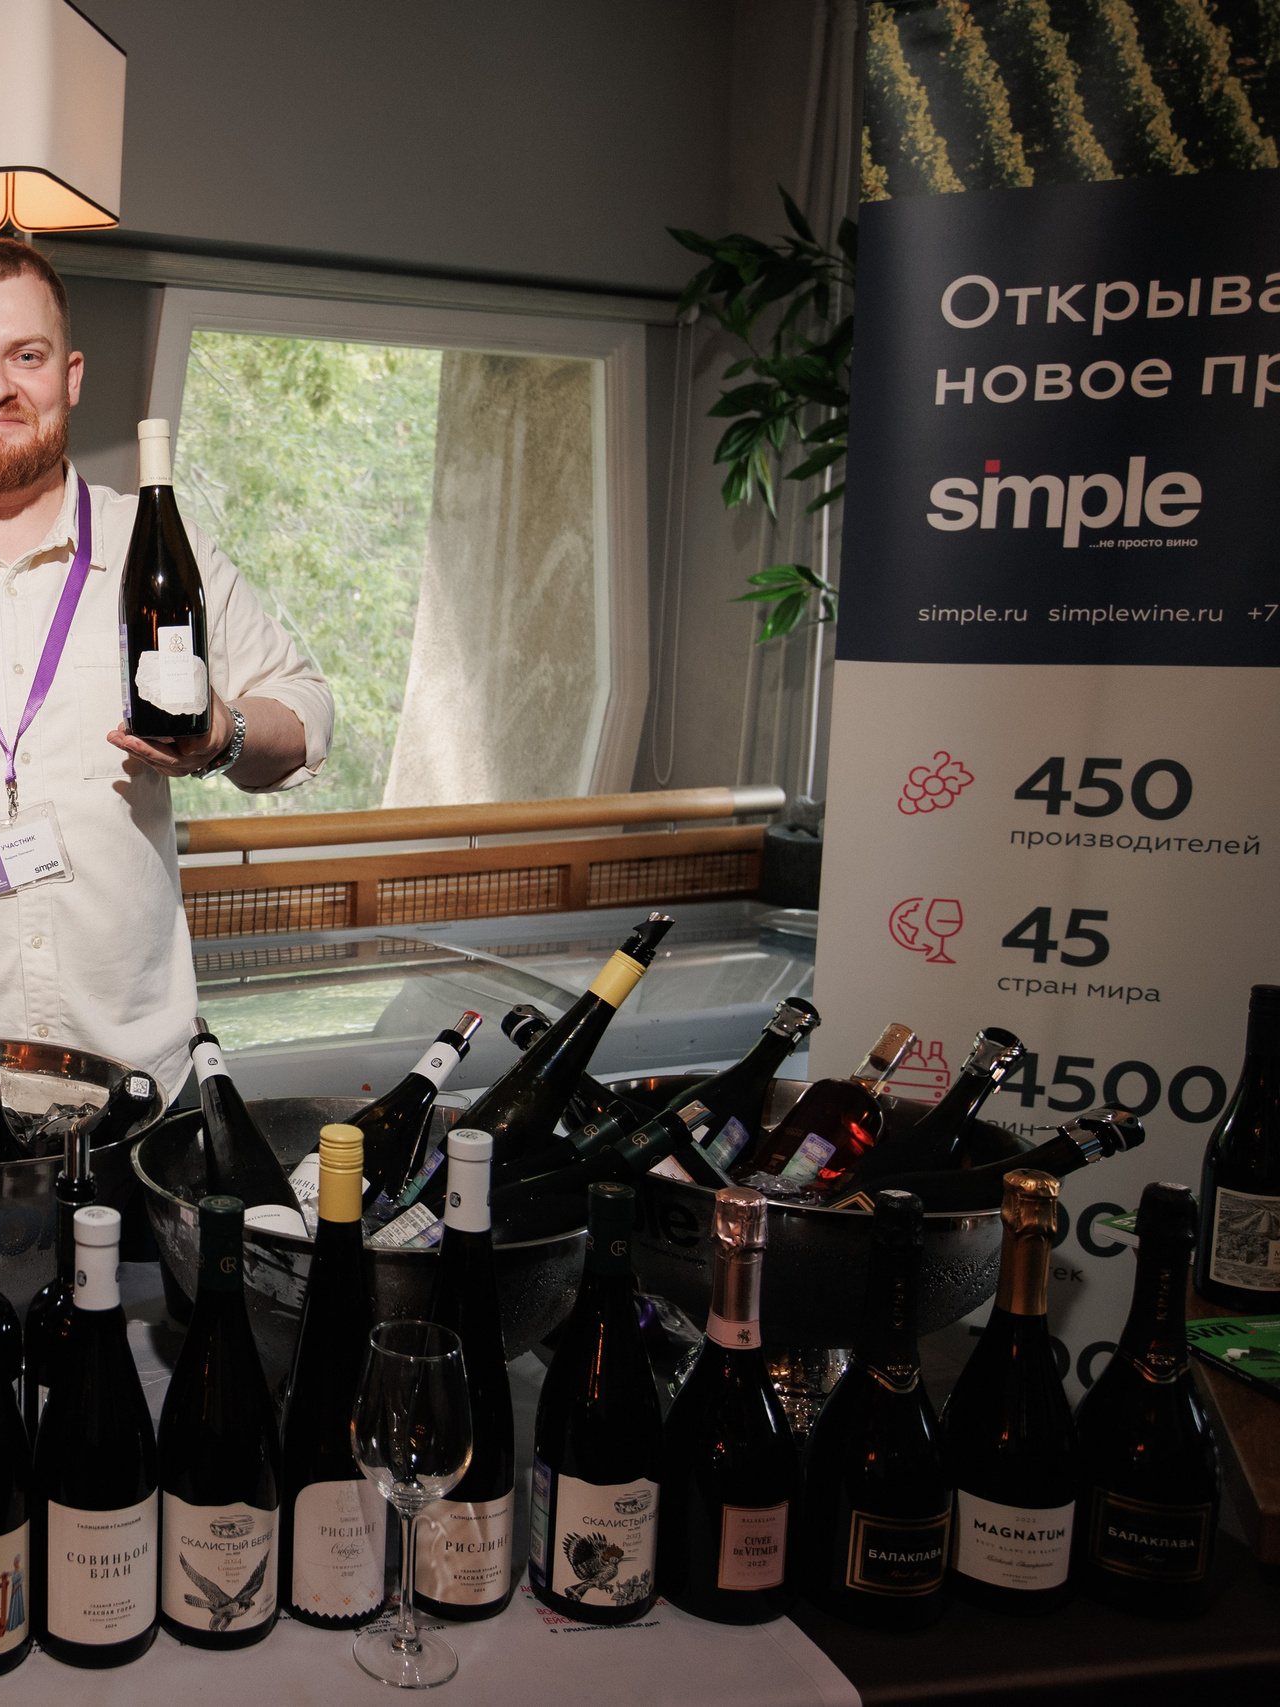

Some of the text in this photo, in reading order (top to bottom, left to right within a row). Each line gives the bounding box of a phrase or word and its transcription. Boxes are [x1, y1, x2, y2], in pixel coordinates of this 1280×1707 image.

[934, 358, 1172, 406] новое
[926, 456, 1203, 549] simple
[1117, 538, 1163, 550] просто
[1165, 537, 1199, 549] вино
[917, 604, 1279, 625] simple.ru simplewine.ru +7
[1014, 755, 1194, 822] 450
[0, 834, 37, 851] УЧАСТНИК
[1009, 828, 1261, 856] производителей
[34, 860, 59, 874] simple
[1001, 905, 1110, 968] 45
[996, 975, 1162, 1005] стран мира
[1002, 1052, 1228, 1125] 4500
[319, 1521, 378, 1538] РИСЛИНГ
[582, 1515, 647, 1529] СКАЛИСТЫЙ
[973, 1518, 1066, 1542] MAGNATUM
[180, 1528, 275, 1552] СКАЛИСТЫЙ БЕРЕГ
[444, 1533, 510, 1554] РИСЛИНГ
[1106, 1525, 1197, 1549] БАЛАКЛАВА
[66, 1542, 149, 1566] СОВИНЬОН
[733, 1543, 779, 1556] DE VITMER
[867, 1547, 943, 1563] БАЛАКЛАВА
[90, 1564, 132, 1579] БЛАН
